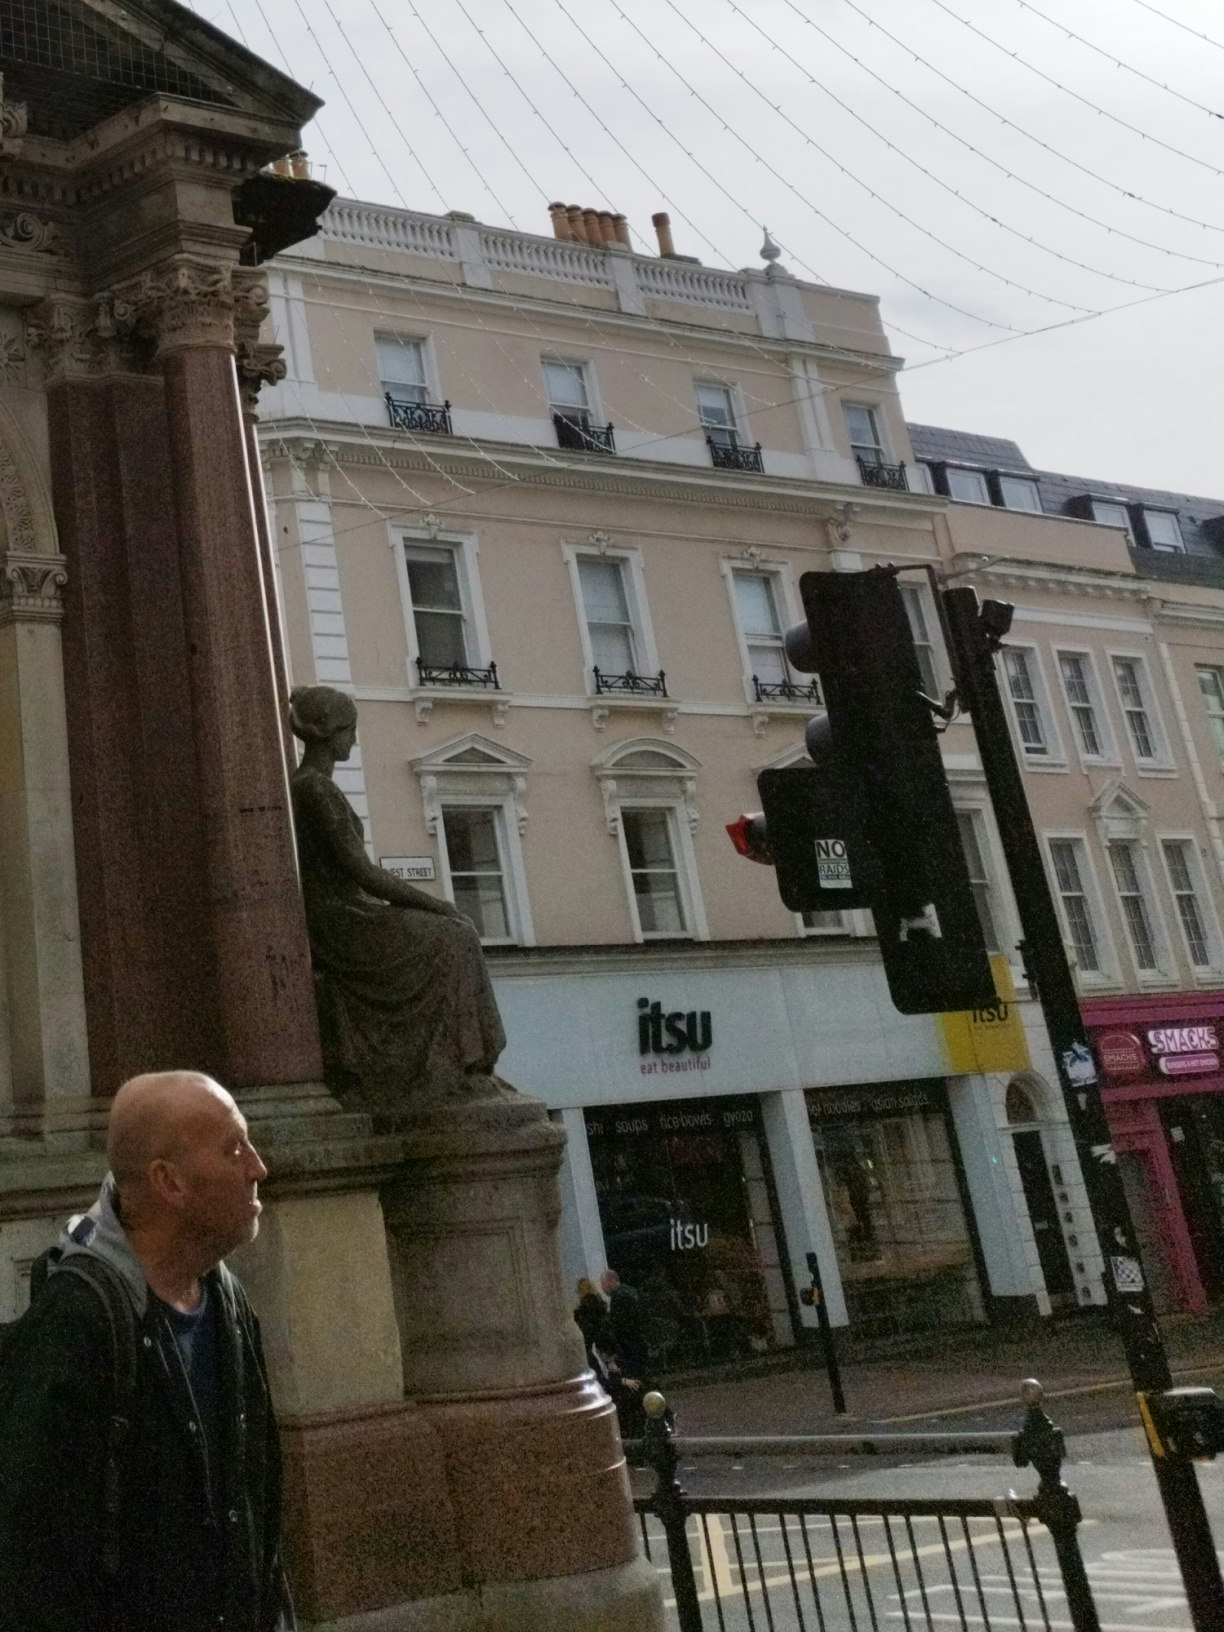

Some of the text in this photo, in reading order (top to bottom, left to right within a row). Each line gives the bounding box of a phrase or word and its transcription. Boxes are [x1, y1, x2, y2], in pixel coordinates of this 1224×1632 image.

[816, 840, 846, 858] NO
[637, 997, 713, 1056] itsu
[1151, 1027, 1218, 1053] SMACKS
[640, 1055, 711, 1074] eat beautiful
[587, 1120, 604, 1136] shi
[616, 1118, 648, 1135] soups
[669, 1218, 708, 1251] itsu
